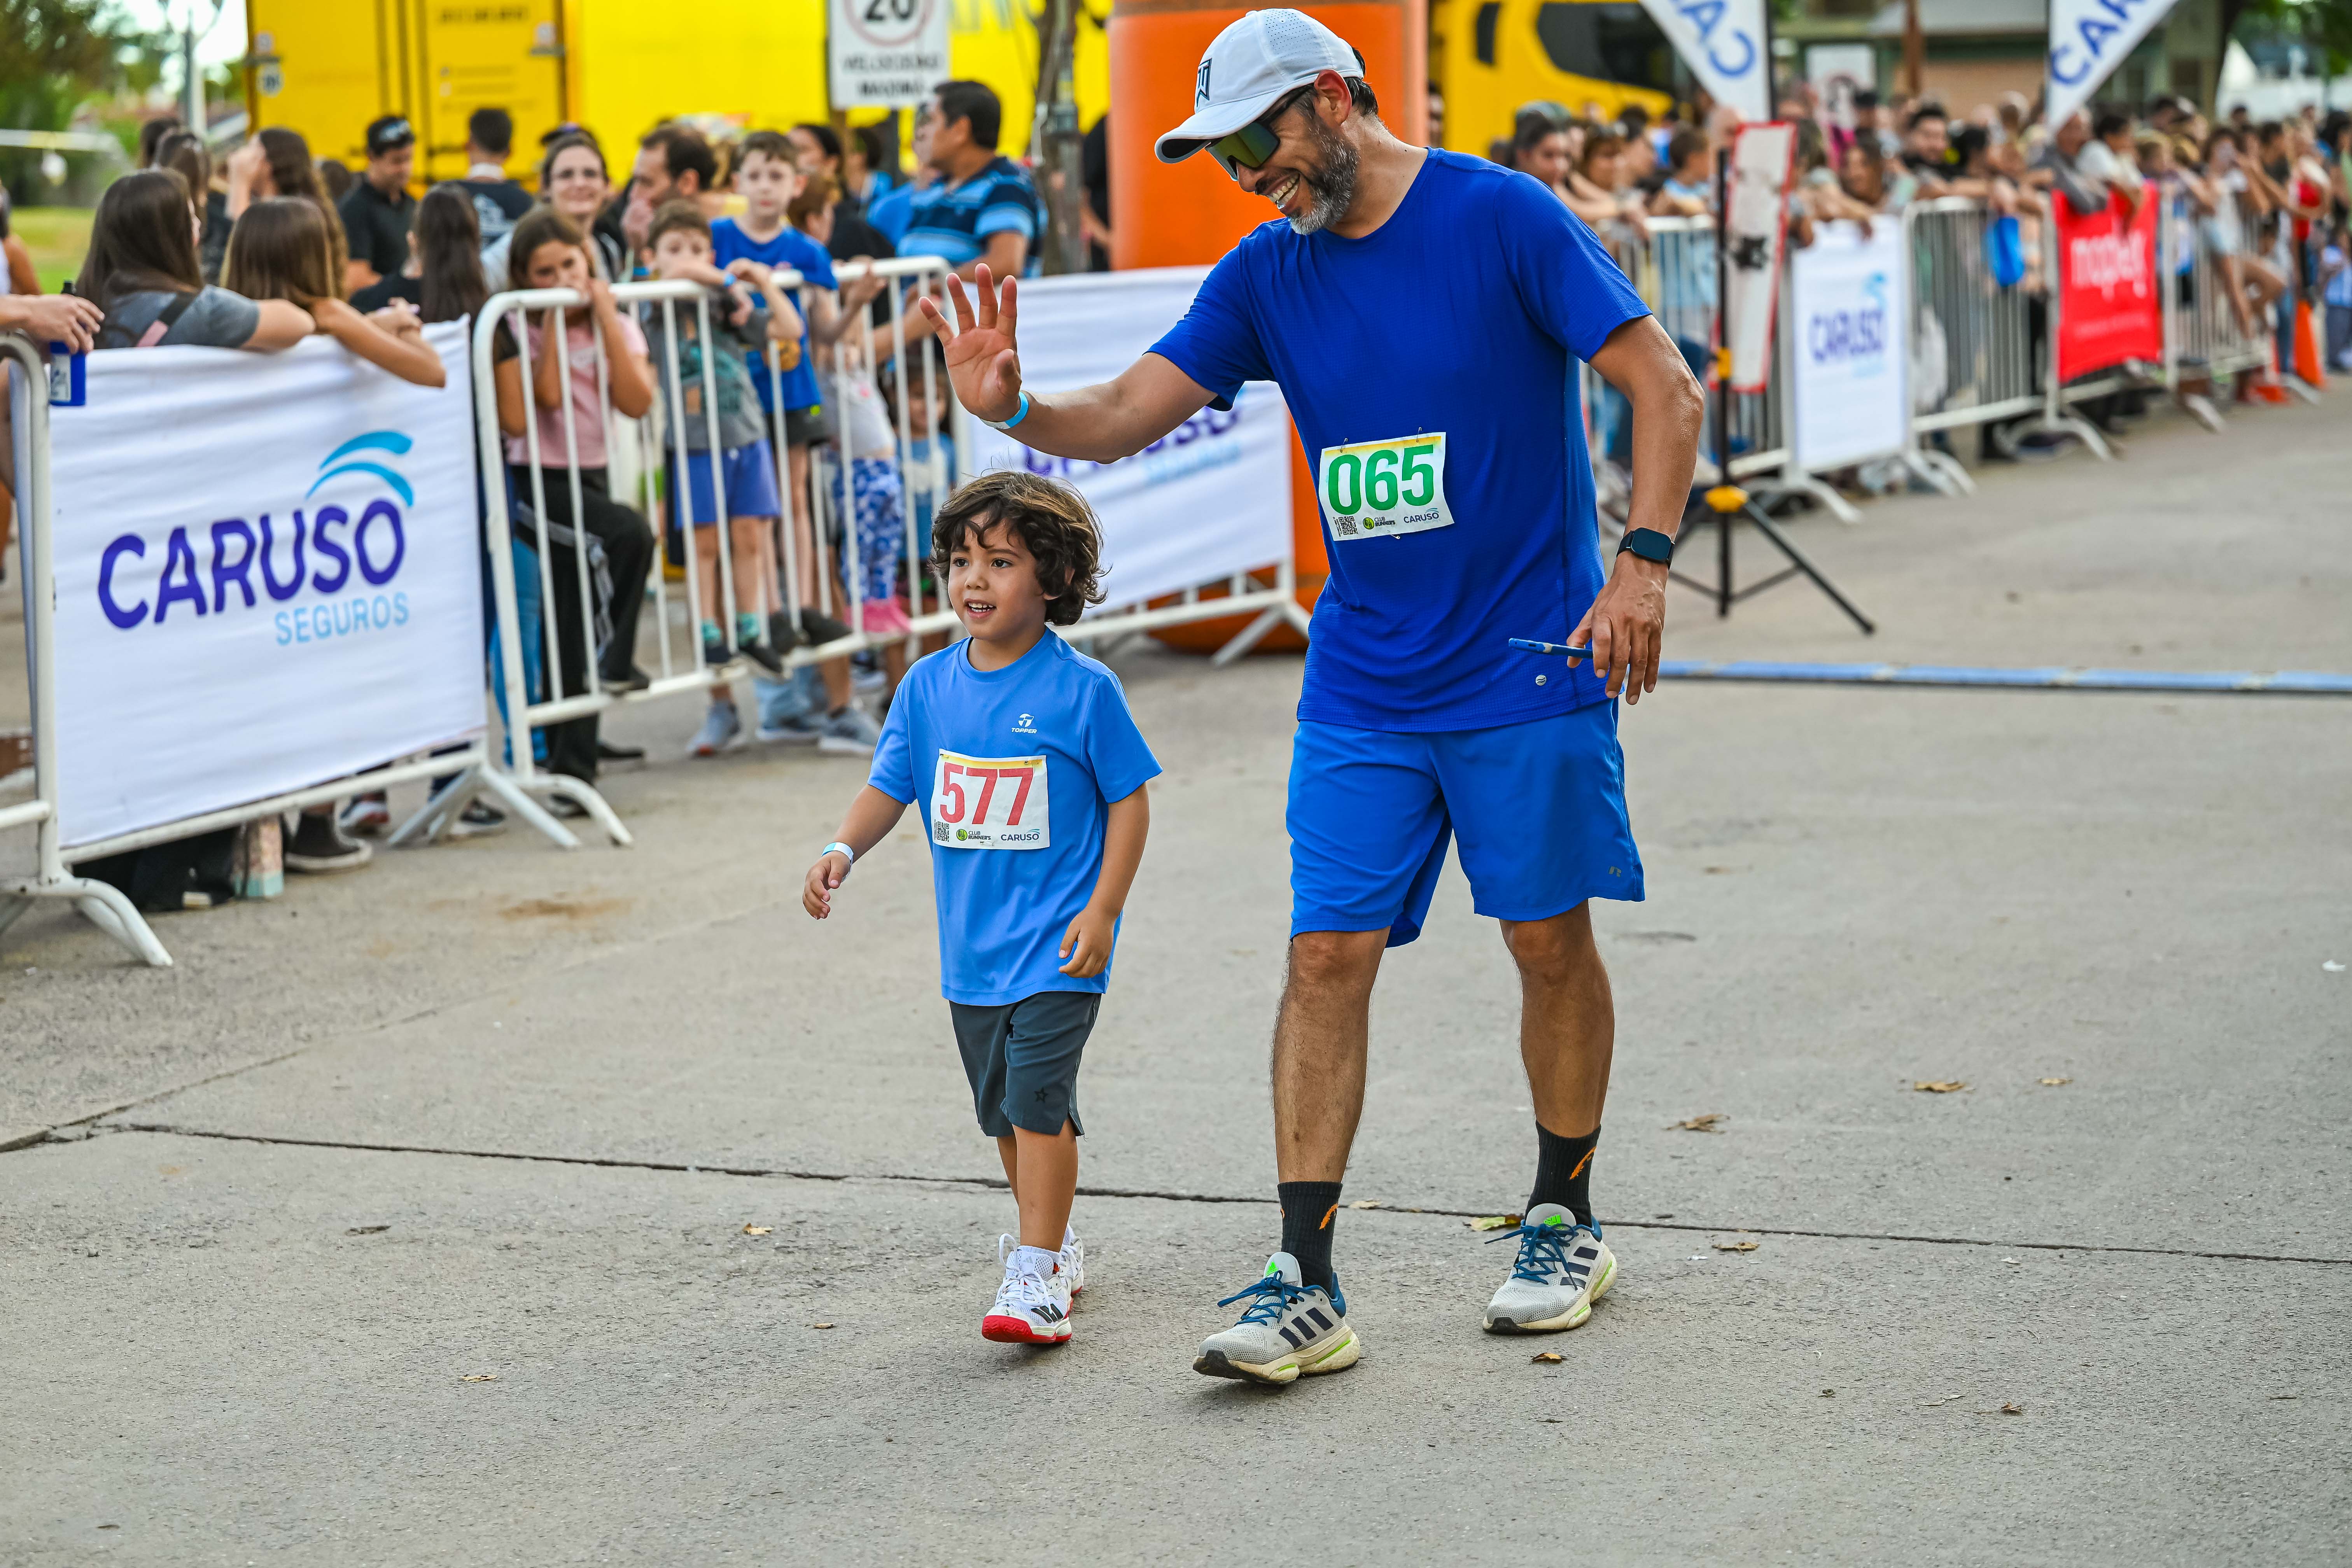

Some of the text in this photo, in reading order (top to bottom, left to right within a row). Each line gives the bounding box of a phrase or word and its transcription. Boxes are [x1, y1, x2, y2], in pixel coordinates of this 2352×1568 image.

[1328, 444, 1434, 515] 065
[1404, 512, 1439, 523] CARUSO
[98, 498, 405, 630] CARUSO
[275, 592, 410, 646] SEGUROS
[940, 762, 1033, 826] 577
